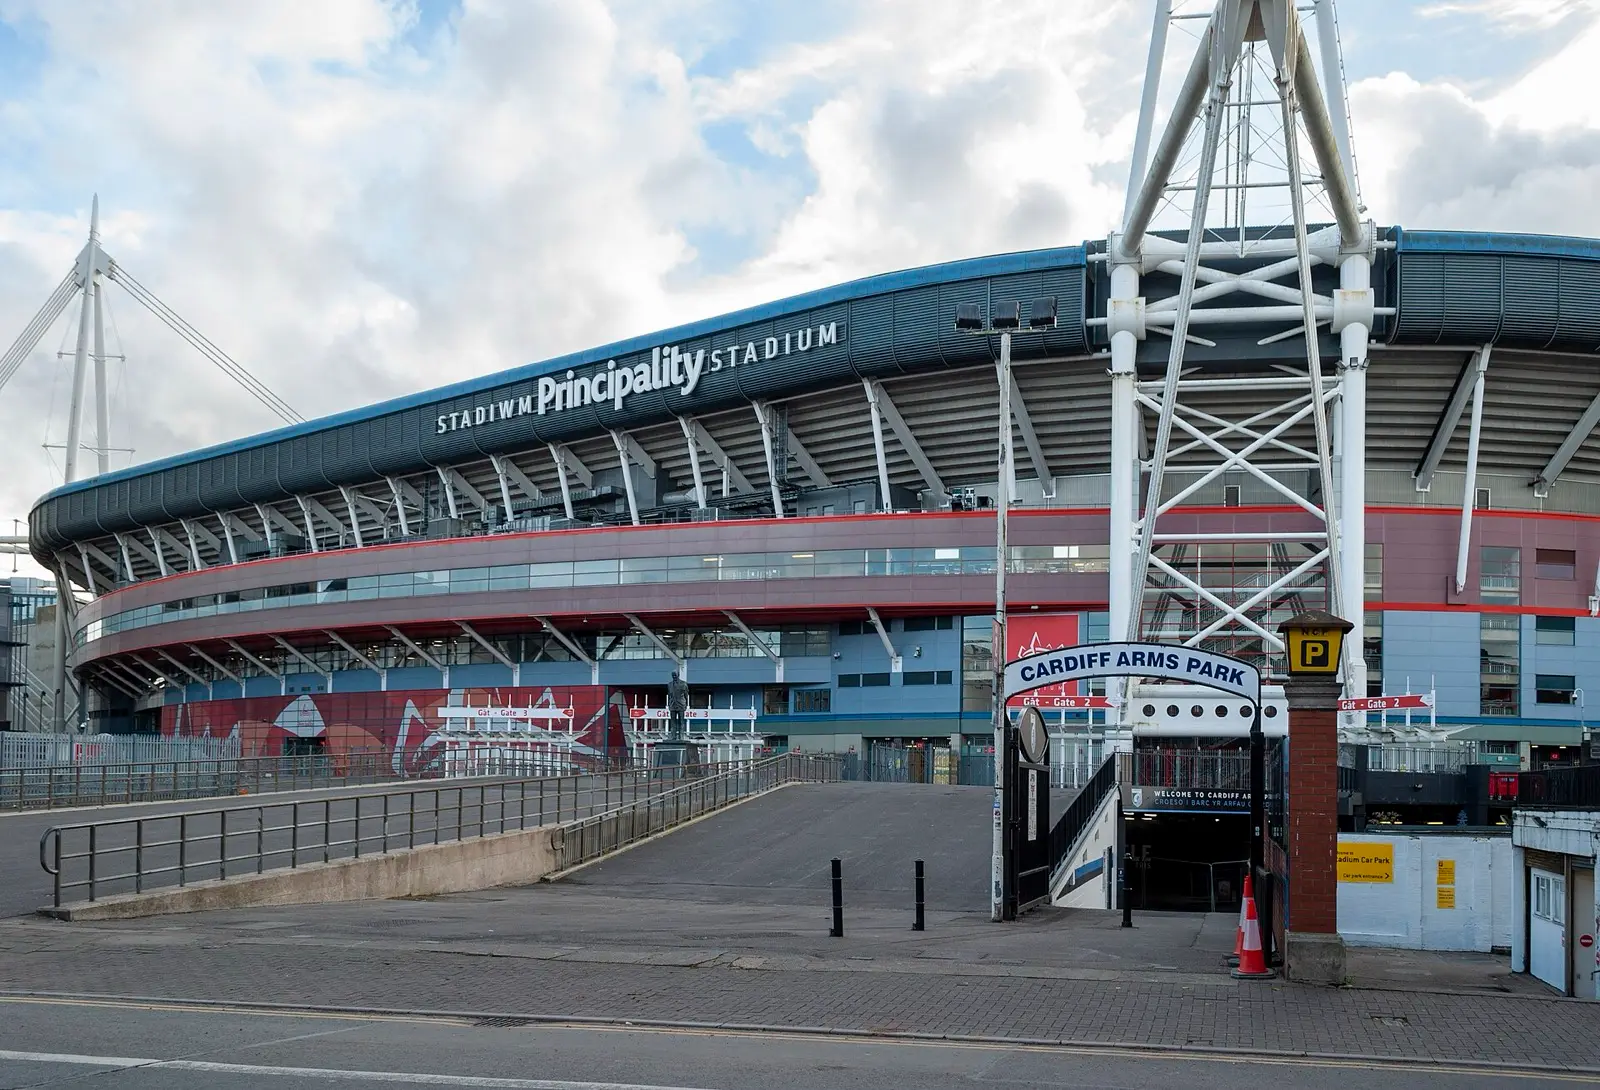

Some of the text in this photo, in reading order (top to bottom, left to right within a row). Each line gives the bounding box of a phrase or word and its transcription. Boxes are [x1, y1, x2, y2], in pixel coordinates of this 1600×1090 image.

[437, 322, 837, 434] STADIWM Principality STADIUM
[1305, 642, 1324, 665] P
[1020, 651, 1247, 686] CARDIFF ARMS PARK
[1053, 697, 1075, 707] Gate
[1084, 698, 1091, 707] 2
[1367, 699, 1387, 709] Gate
[1394, 698, 1400, 707] 2
[500, 709, 517, 717] Gate
[523, 709, 528, 717] 3
[685, 710, 697, 718] ate
[1154, 790, 1192, 798] WELCOME
[1207, 791, 1240, 799] CARDIFF
[1154, 798, 1184, 806] CROESO
[1361, 856, 1373, 864] Car
[1374, 856, 1390, 864] Park
